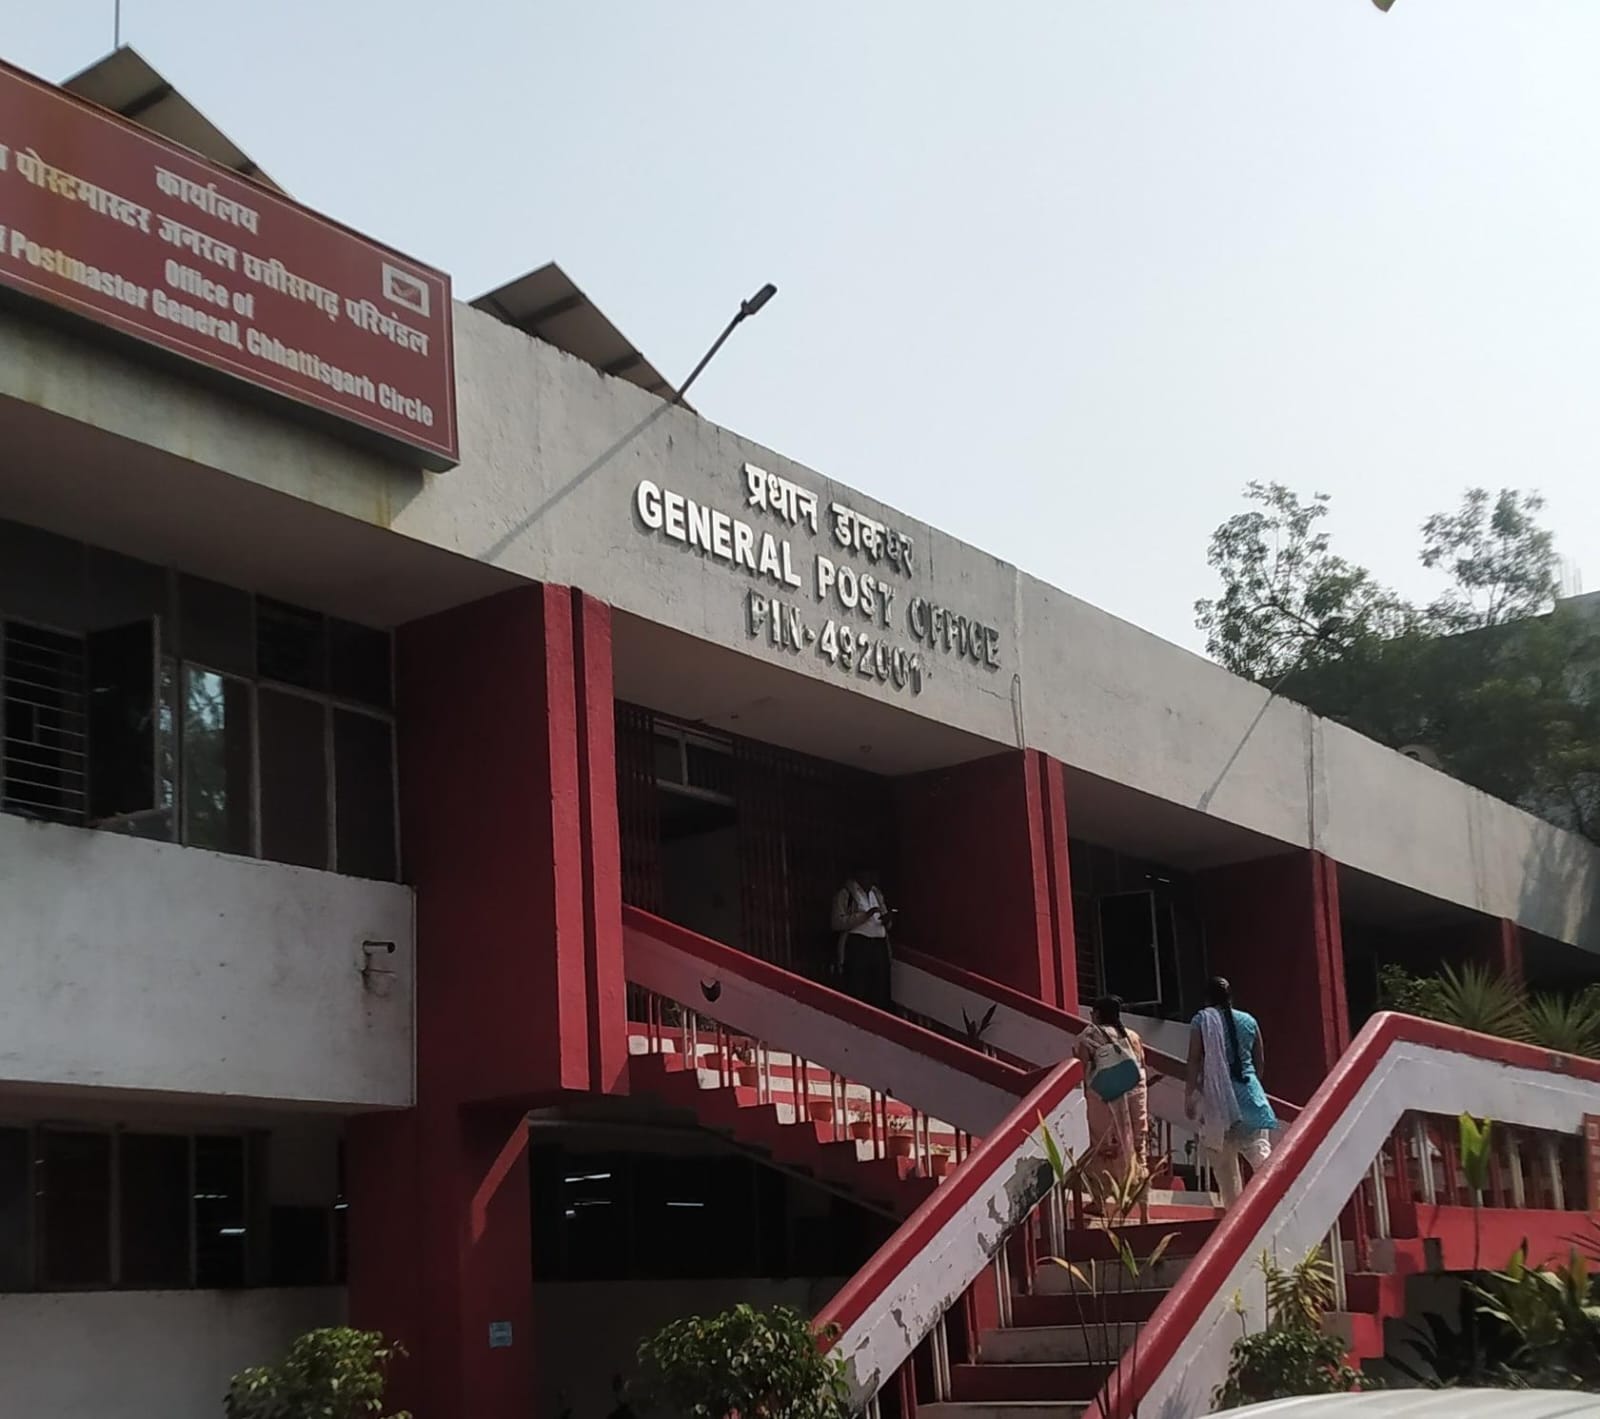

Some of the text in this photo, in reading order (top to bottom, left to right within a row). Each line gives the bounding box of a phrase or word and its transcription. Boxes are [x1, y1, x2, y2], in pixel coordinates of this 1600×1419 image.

[14, 146, 152, 234] पोस्टमास्टर
[156, 213, 238, 271] जनरल
[344, 298, 430, 357] परिमंडल
[154, 165, 259, 235] कार्यालय
[11, 229, 149, 310] Postmaster
[152, 288, 244, 351] General,
[246, 327, 376, 403] Chhattisgarh
[378, 383, 434, 427] Circle
[165, 258, 255, 320] Office of
[637, 479, 1000, 669] GENERAL POST OFFICE
[744, 462, 914, 578] प्रधान डाकघर
